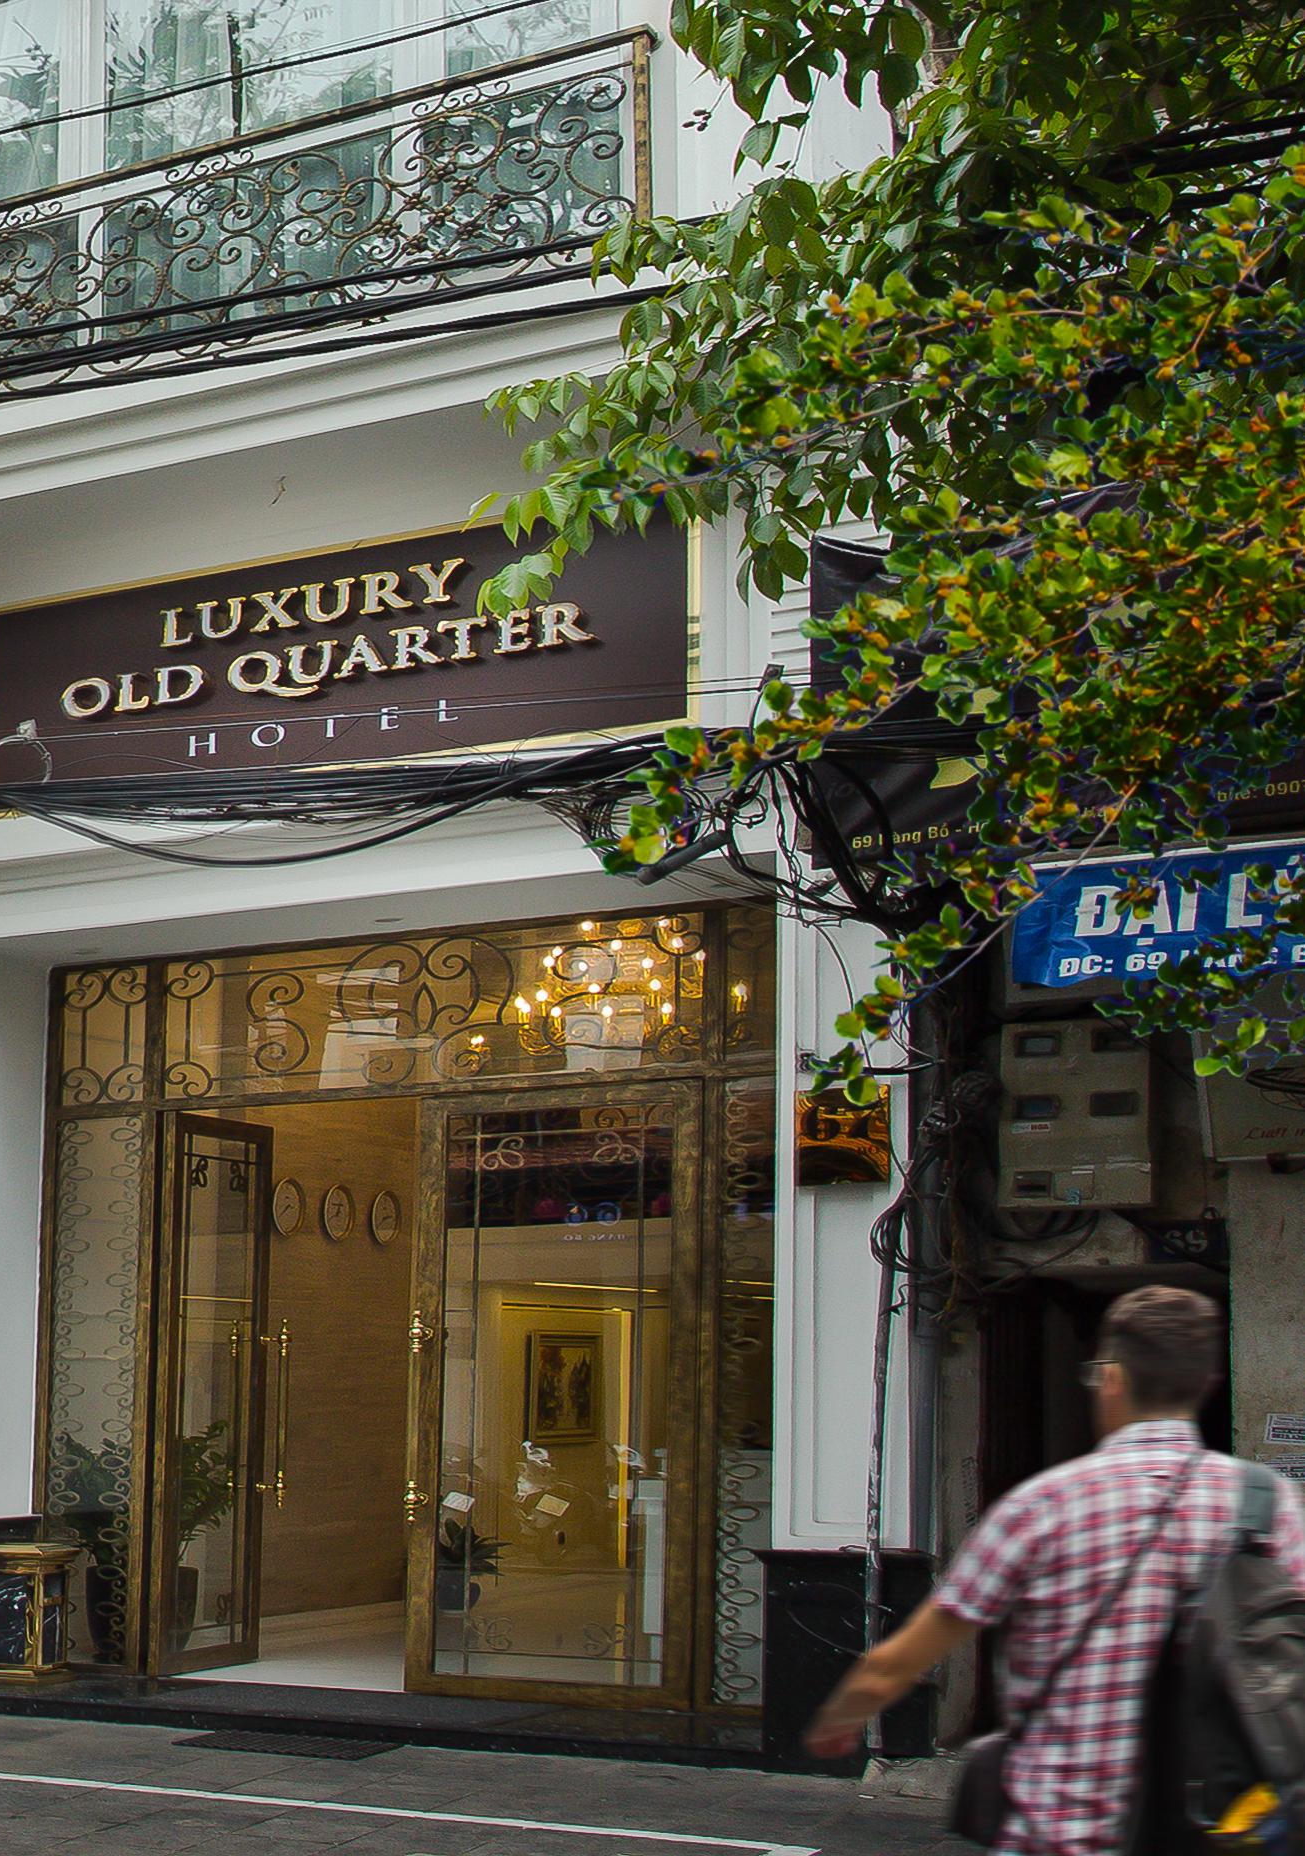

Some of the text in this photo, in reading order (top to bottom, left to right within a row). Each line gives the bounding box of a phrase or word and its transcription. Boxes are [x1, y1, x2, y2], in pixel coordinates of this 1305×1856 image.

[160, 558, 464, 647] LUXURY
[61, 601, 595, 718] OLD QUARTER
[188, 700, 459, 757] HOTEL
[1058, 954, 1114, 977] ĐC:
